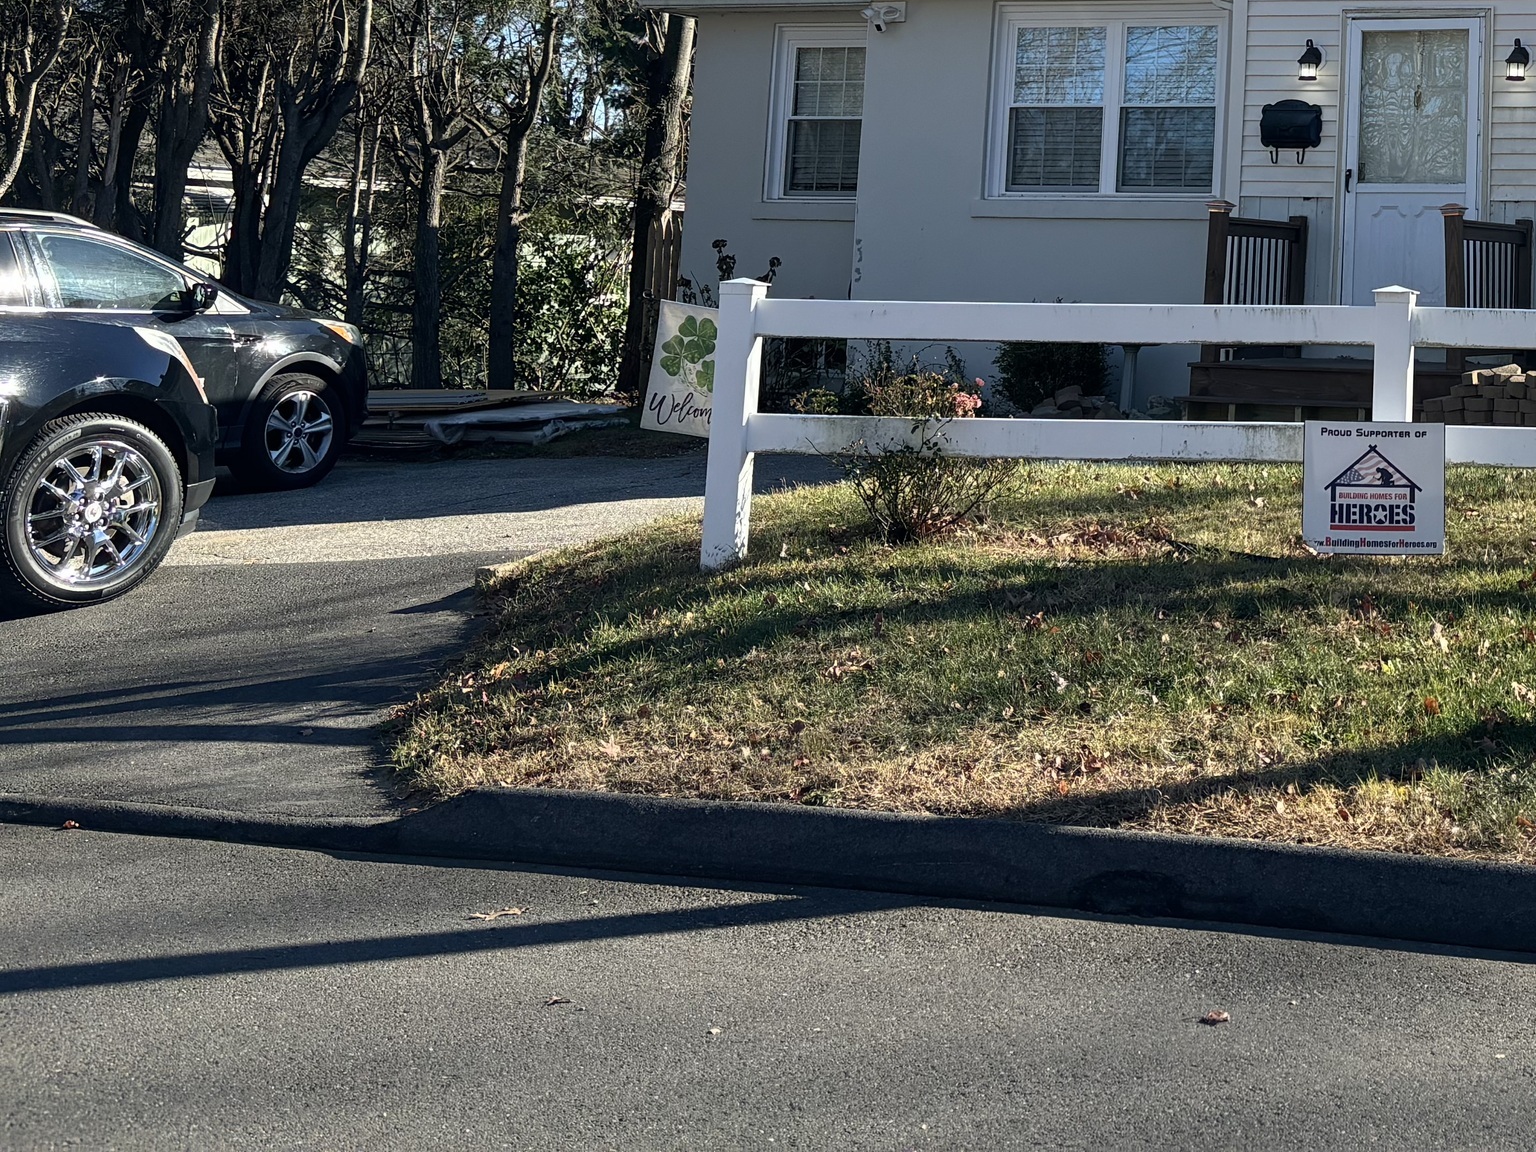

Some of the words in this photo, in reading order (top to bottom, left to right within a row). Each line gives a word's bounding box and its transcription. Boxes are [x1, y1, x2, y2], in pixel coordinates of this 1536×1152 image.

[649, 392, 712, 424] Welcom
[16, 450, 48, 502] MICHELIN
[1338, 492, 1368, 500] BUILDING
[1370, 492, 1393, 500] HOMES
[1394, 493, 1408, 501] FOR
[1330, 503, 1416, 525] HEROES
